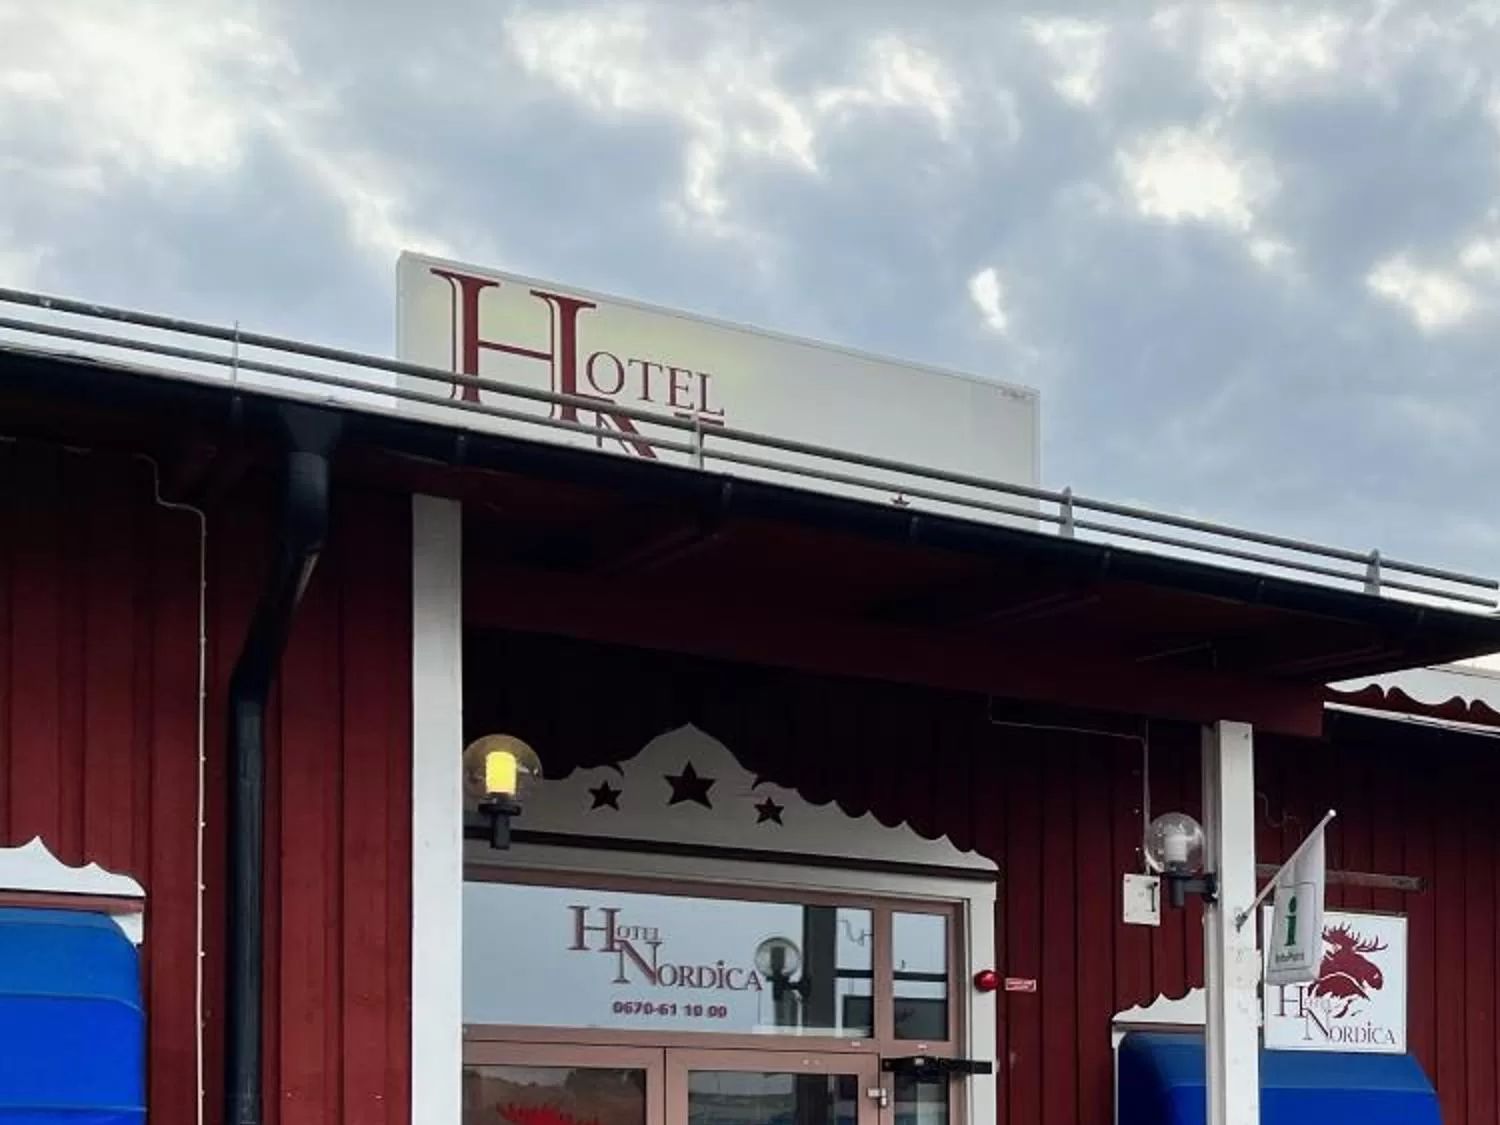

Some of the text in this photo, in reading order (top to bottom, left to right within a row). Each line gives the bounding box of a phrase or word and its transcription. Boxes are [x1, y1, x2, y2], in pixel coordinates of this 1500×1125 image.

[430, 267, 725, 424] HOTEL
[612, 939, 764, 991] NORDICA
[612, 1001, 728, 1019] 0670-61 10 00
